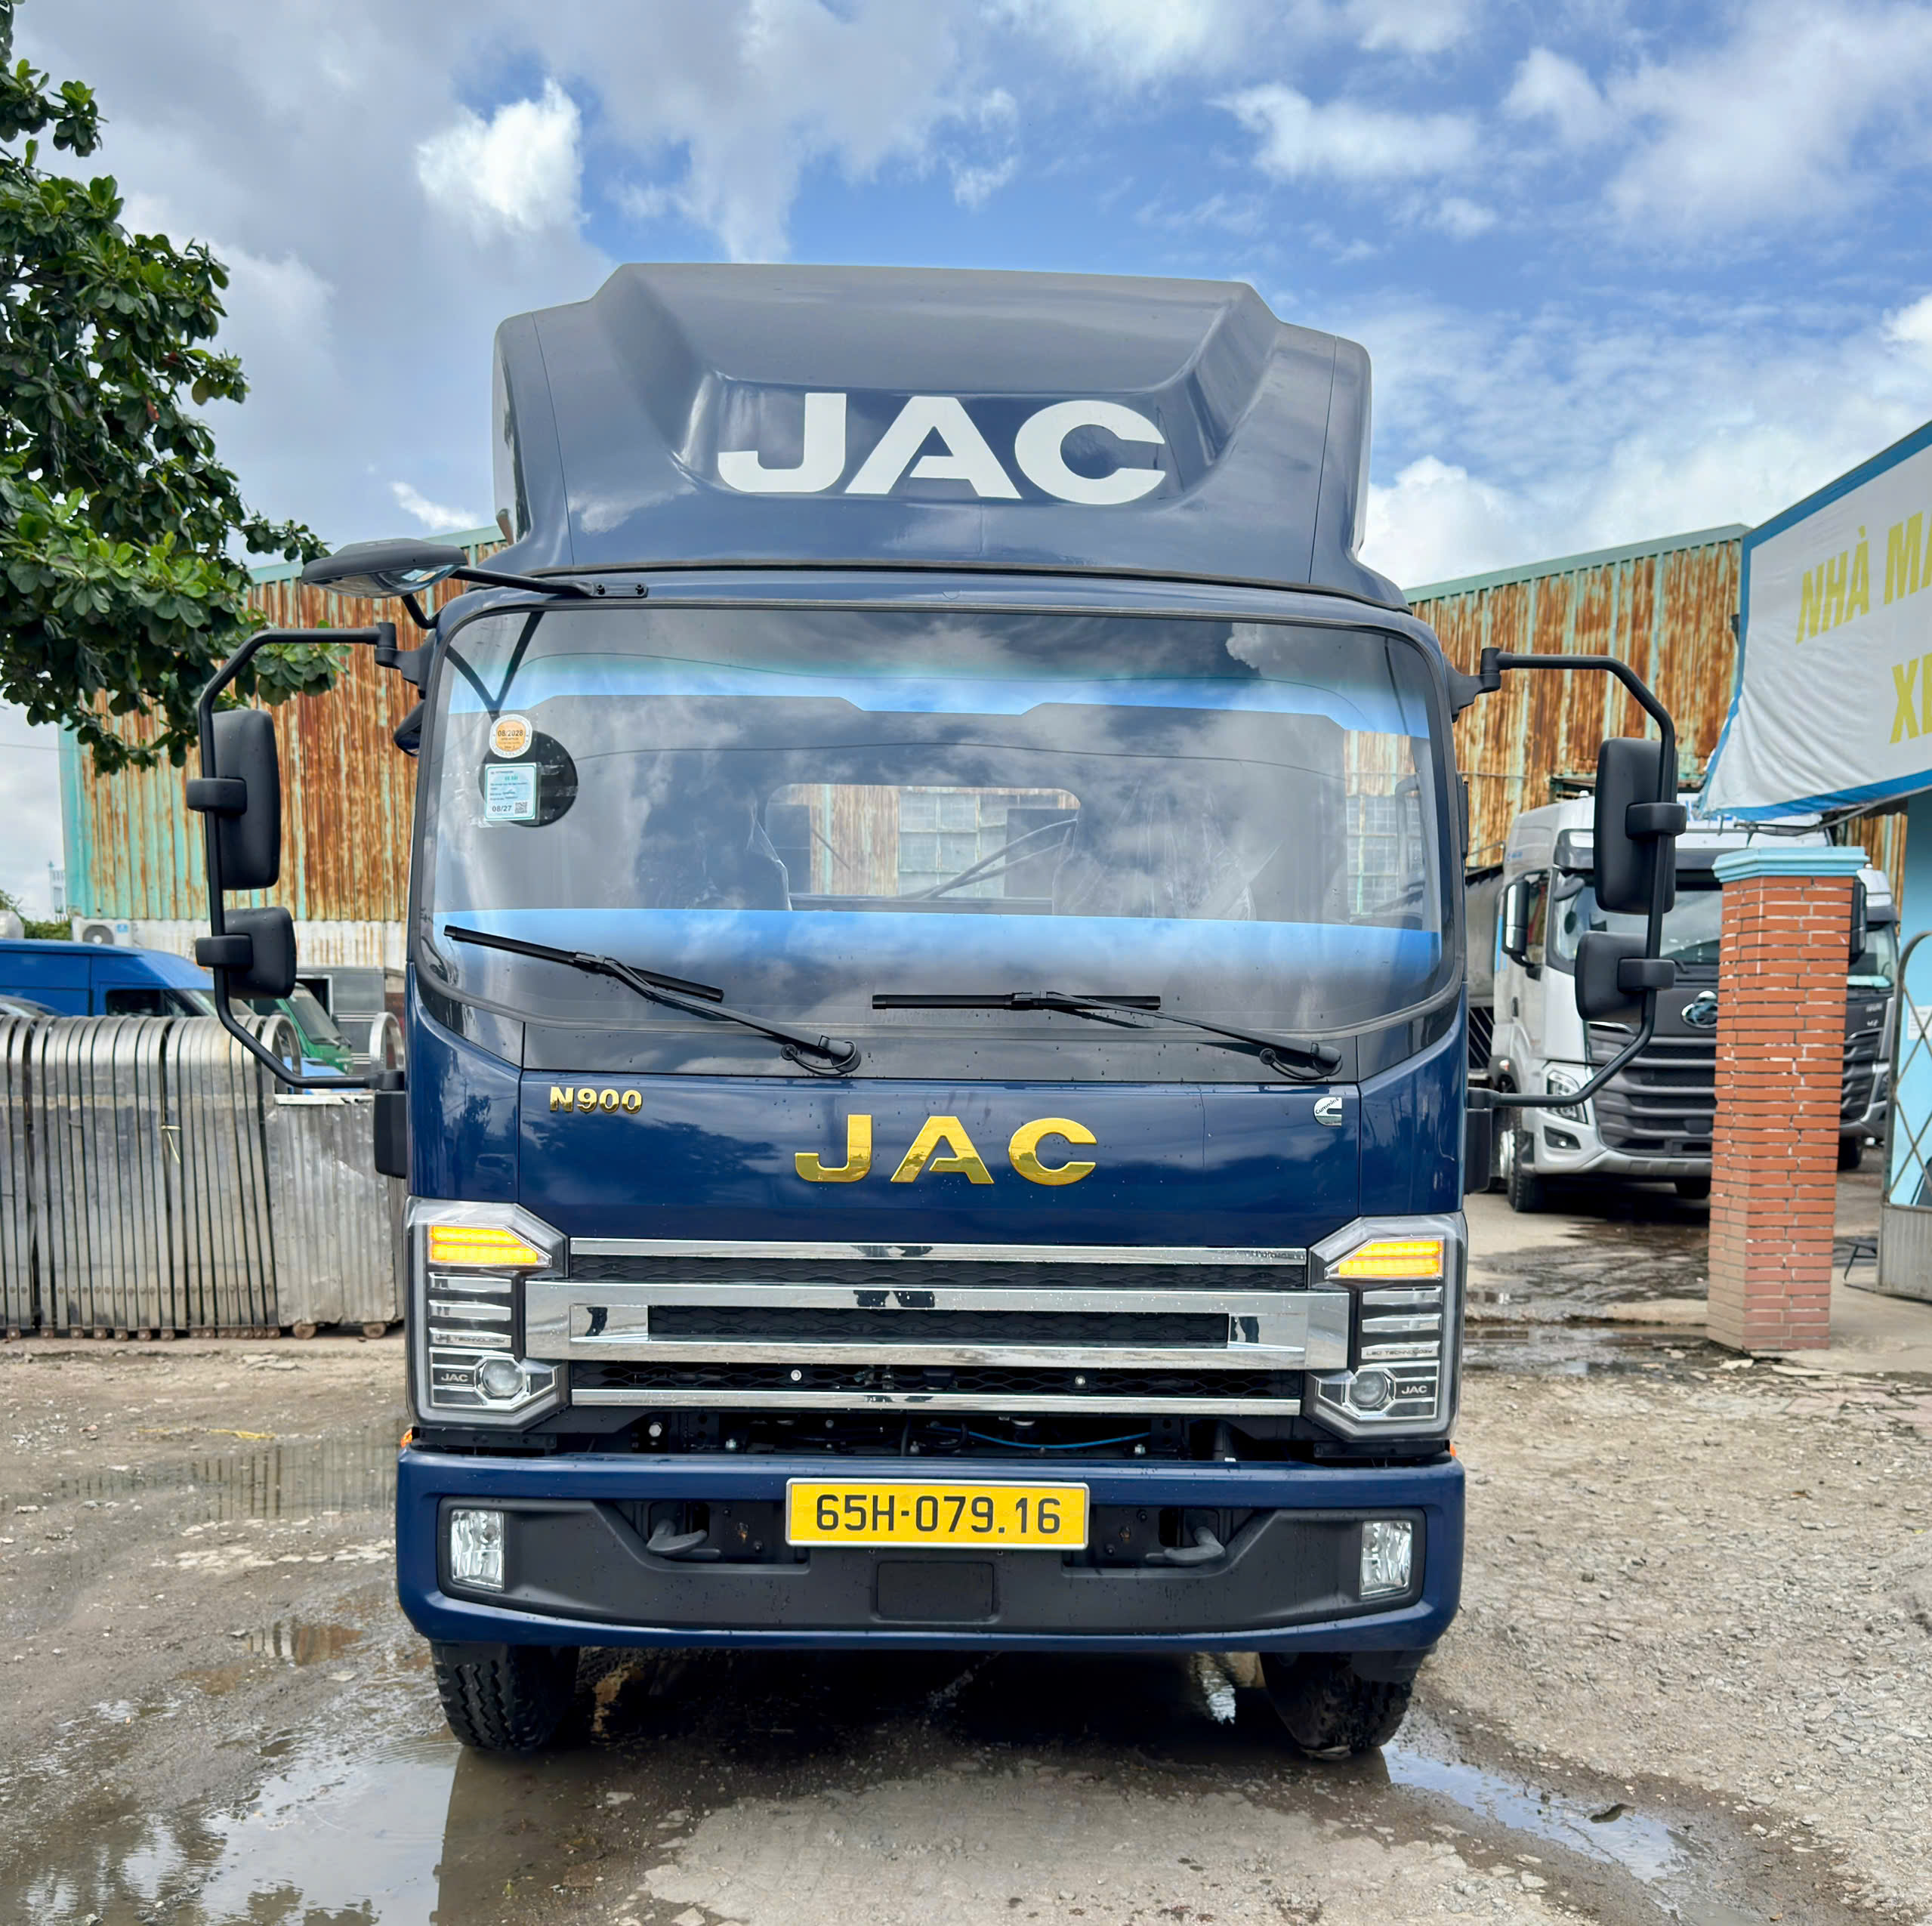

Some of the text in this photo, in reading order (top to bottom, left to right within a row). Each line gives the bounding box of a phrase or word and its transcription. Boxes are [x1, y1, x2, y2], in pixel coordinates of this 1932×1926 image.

[718, 392, 1165, 505] JAC
[1795, 526, 1870, 647] NHÀ
[549, 1086, 643, 1114] N900
[795, 1113, 1098, 1187] JAC
[440, 1373, 469, 1382] JAC
[1401, 1385, 1427, 1395] JAC
[816, 1494, 1061, 1534] 65H-079.16
